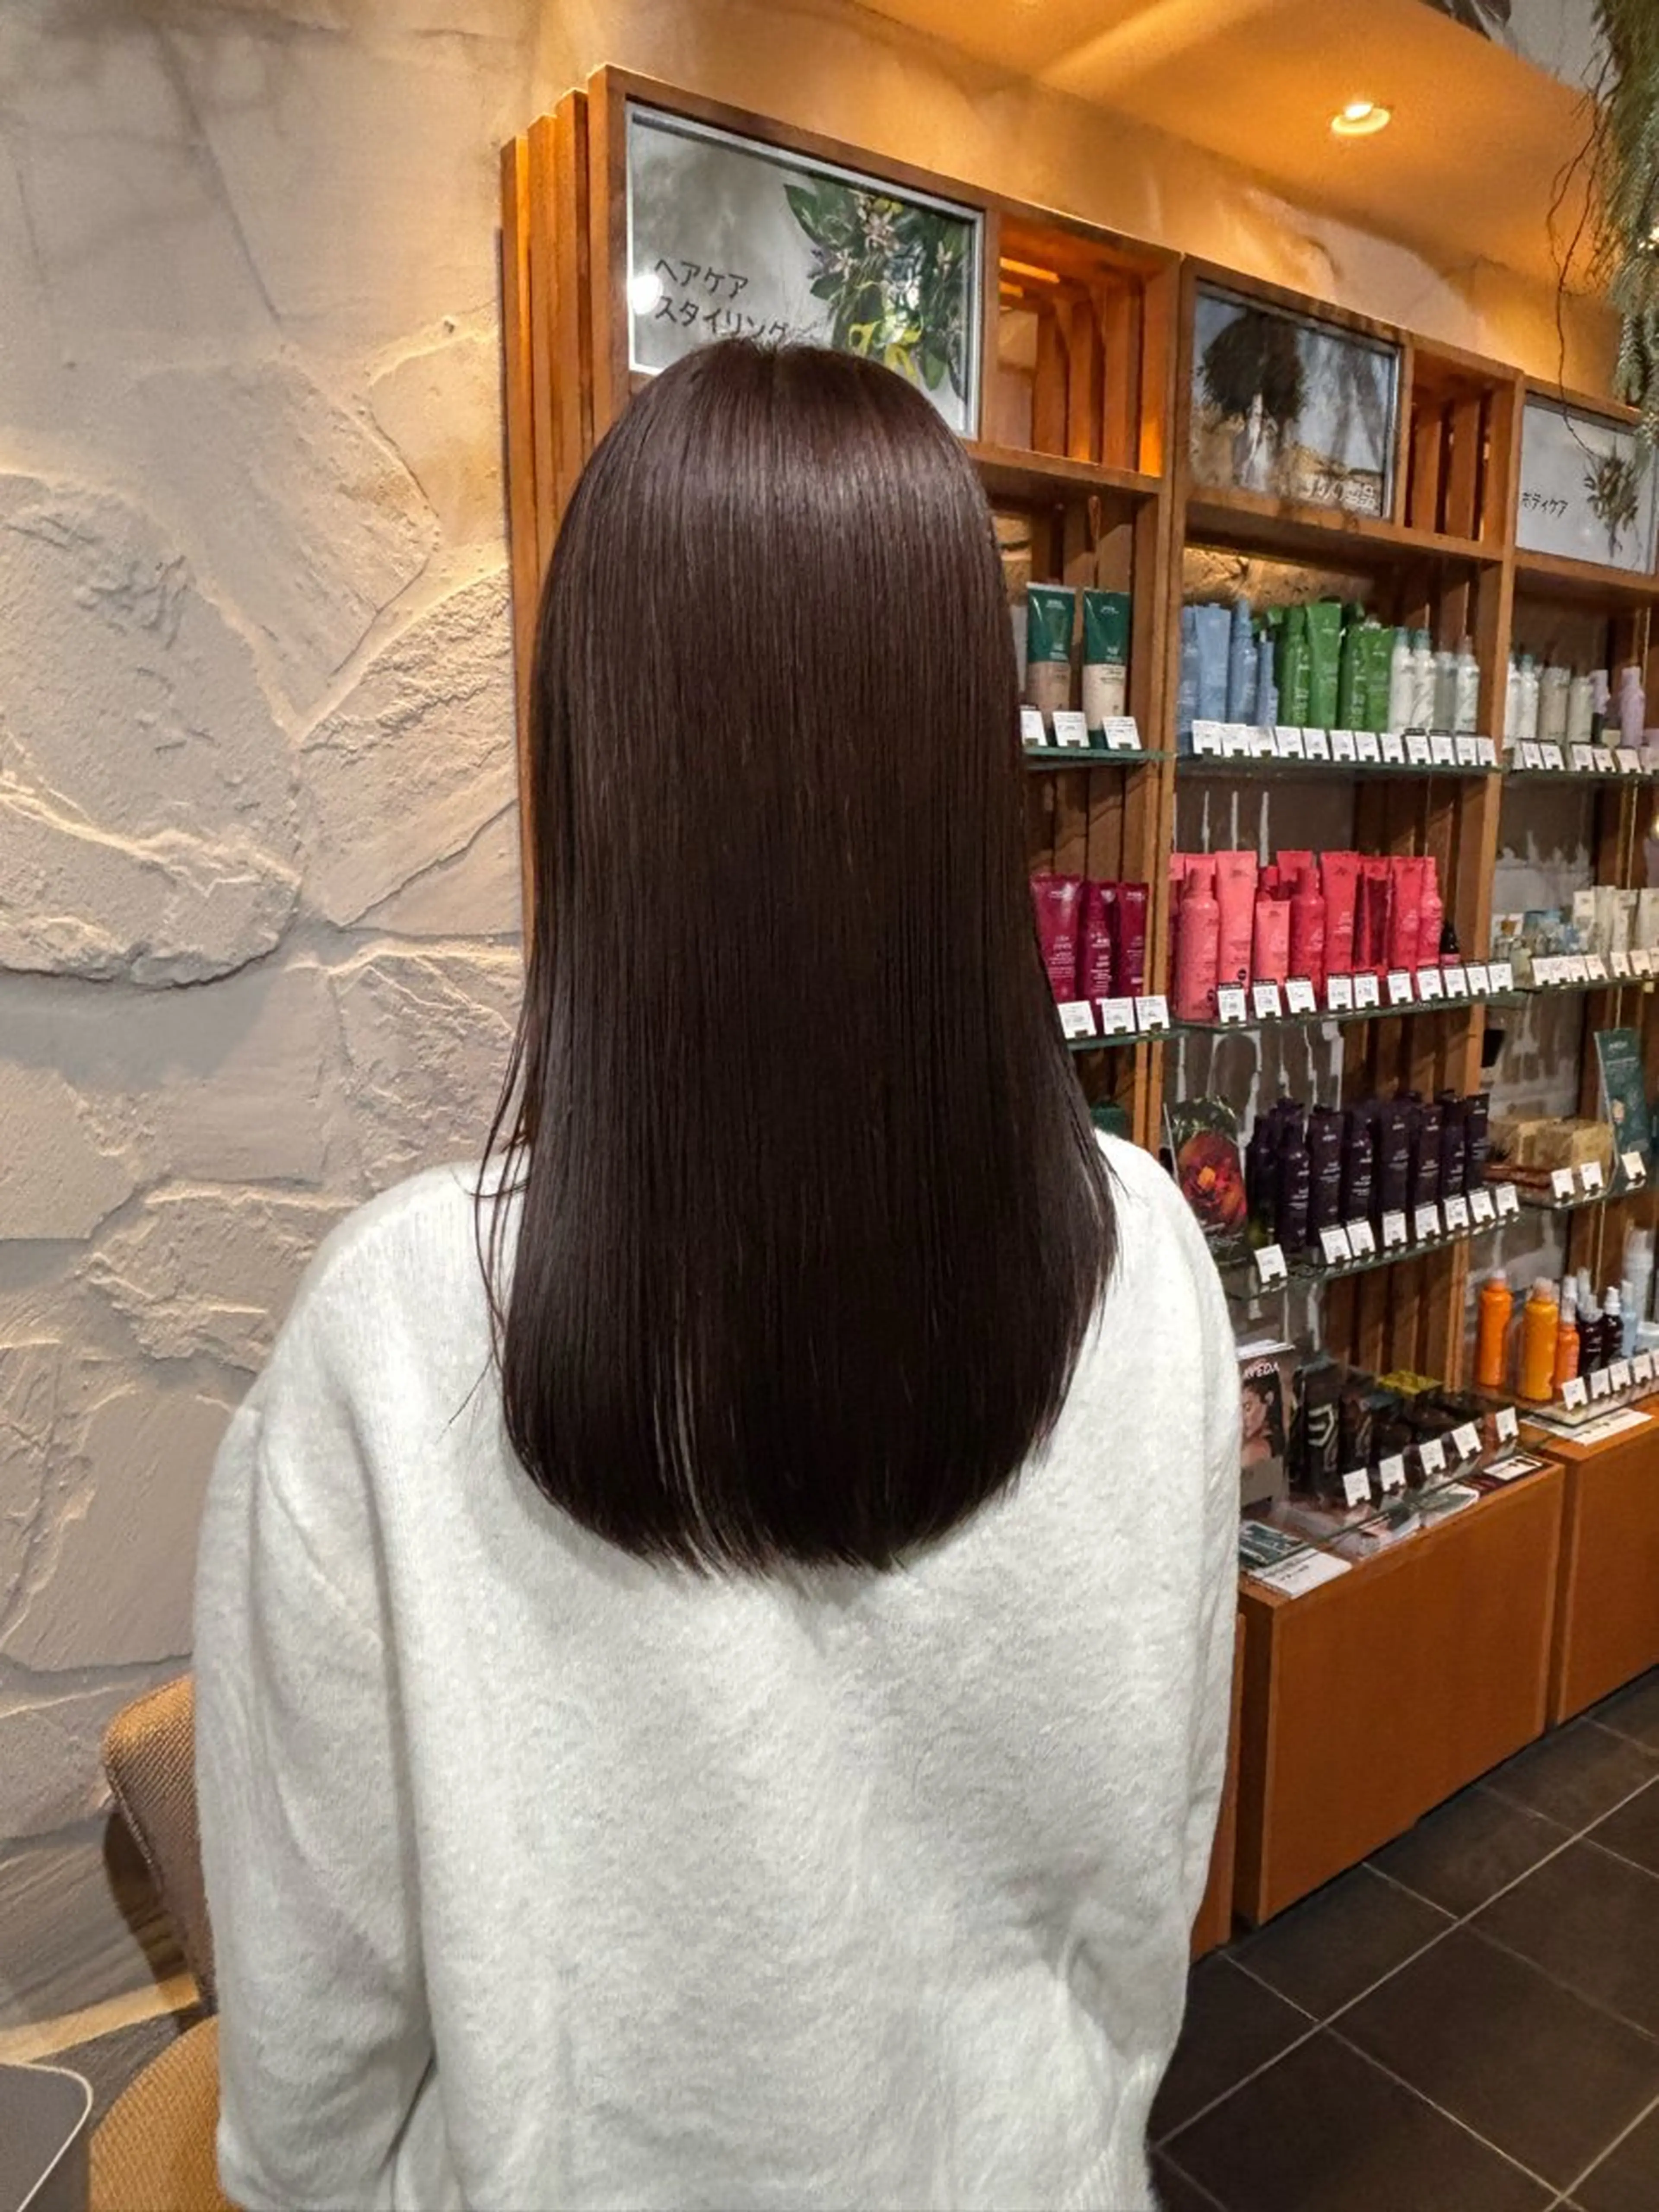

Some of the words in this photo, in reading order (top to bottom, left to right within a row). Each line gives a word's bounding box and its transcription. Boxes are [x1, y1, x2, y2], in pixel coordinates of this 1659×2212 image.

[654, 259, 748, 298] ヘアケア
[655, 296, 789, 343] スタイリング
